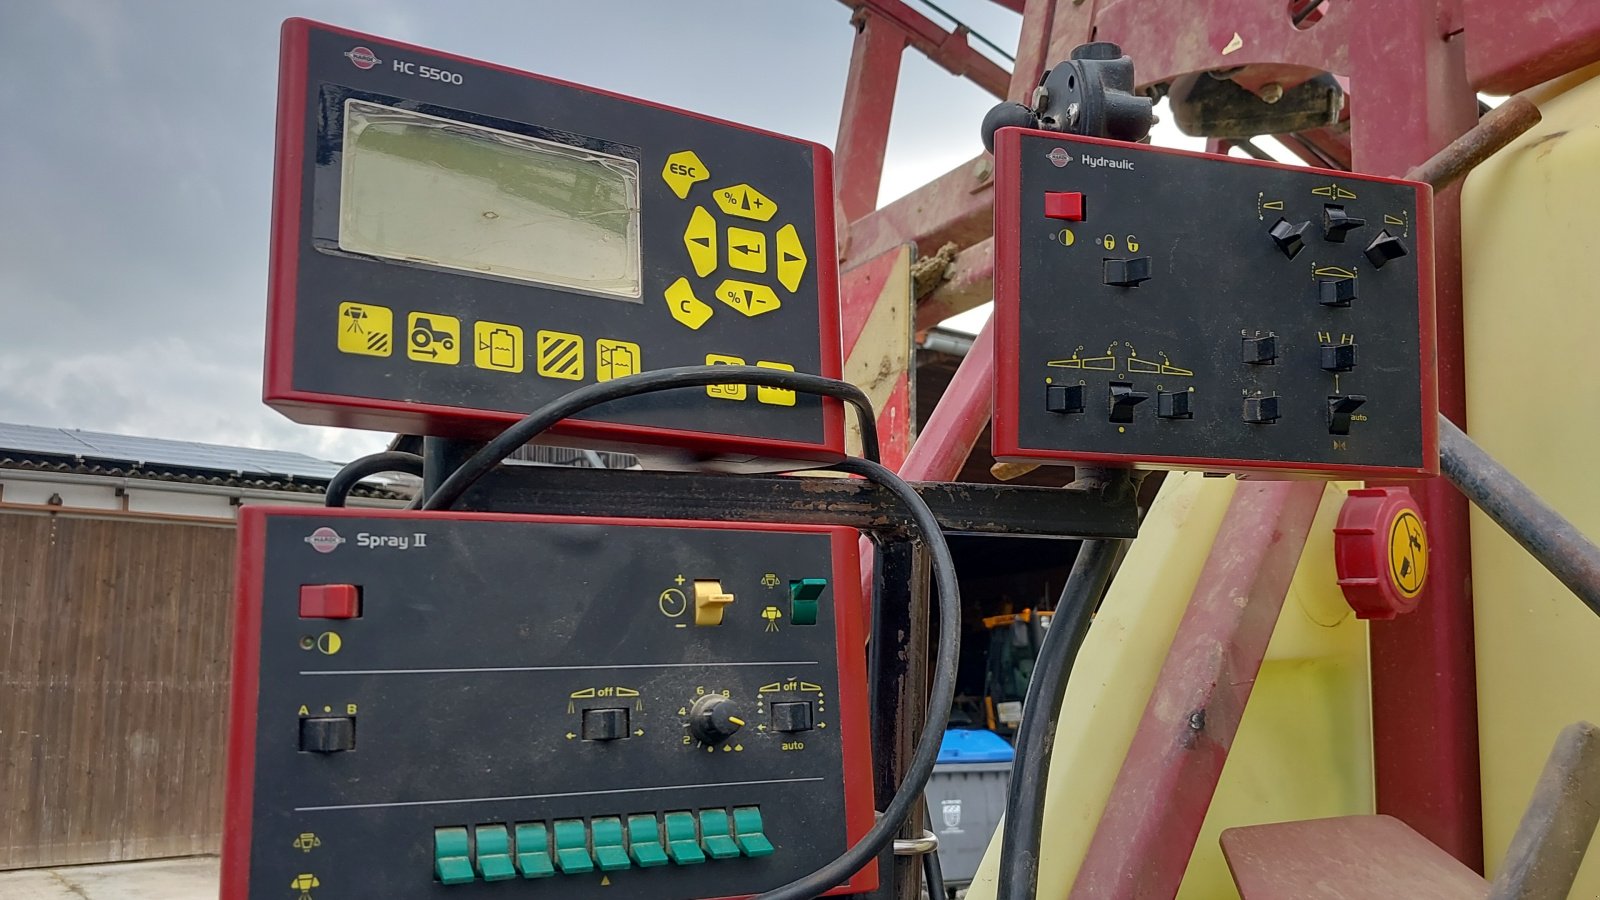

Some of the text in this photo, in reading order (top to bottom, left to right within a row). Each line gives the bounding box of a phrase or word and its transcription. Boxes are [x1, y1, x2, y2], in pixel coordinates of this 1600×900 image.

[393, 60, 463, 85] HC 5500
[1081, 154, 1135, 170] Hydraulic
[670, 163, 696, 178] ESC
[680, 300, 691, 314] C
[1242, 388, 1248, 396] H
[1350, 413, 1368, 422] auto
[356, 532, 427, 550] Spray II
[696, 686, 705, 695] 6
[783, 681, 798, 691] off
[597, 686, 614, 697] off
[722, 690, 730, 699] 8
[298, 703, 358, 716] A B
[677, 707, 686, 716] 4
[682, 735, 691, 745] 2
[782, 741, 804, 751] auto
